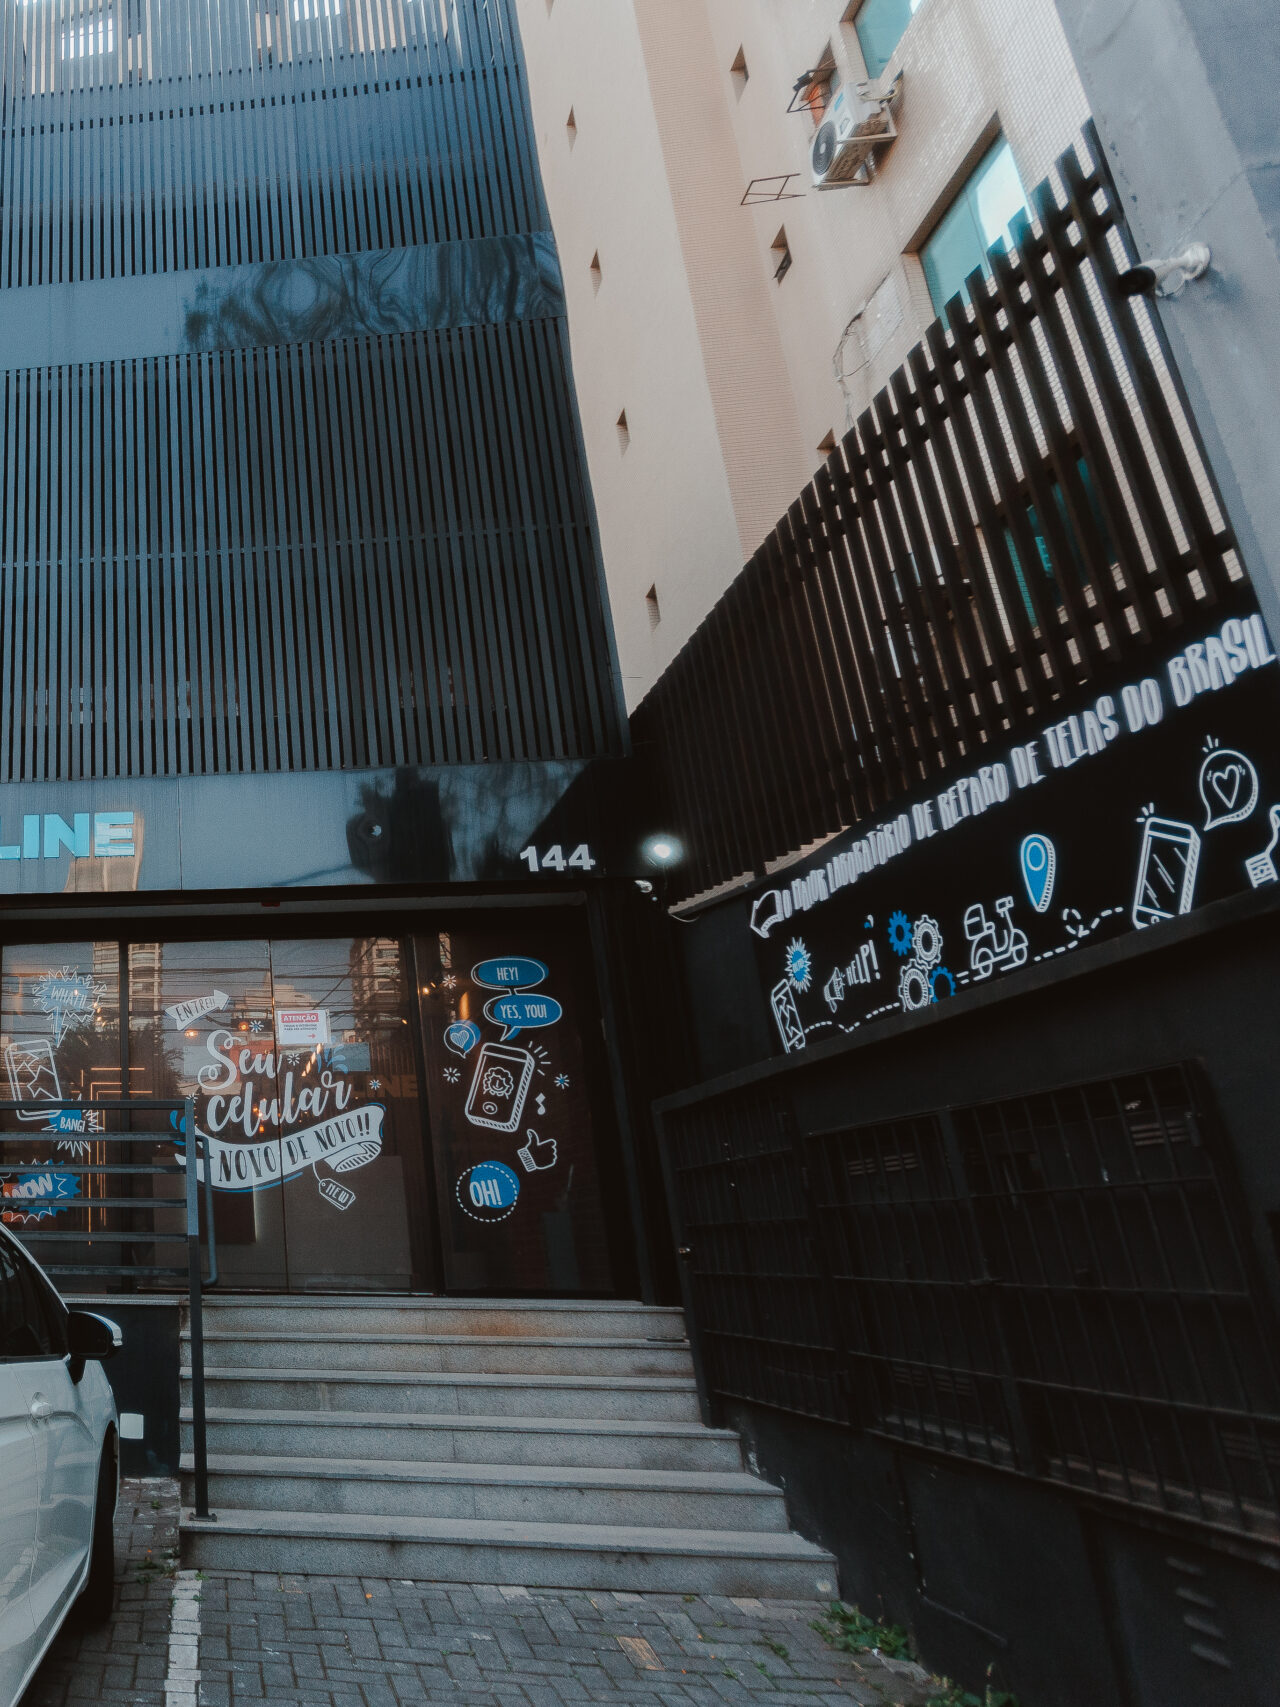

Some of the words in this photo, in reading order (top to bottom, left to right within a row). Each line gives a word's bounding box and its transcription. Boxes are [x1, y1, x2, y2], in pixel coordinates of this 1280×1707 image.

[791, 869, 829, 911] MAIOR
[912, 800, 939, 840] DE
[937, 763, 1010, 831] REPARO
[1010, 741, 1047, 789] DE
[1042, 695, 1120, 768] TELAS
[1121, 678, 1163, 733] DO
[1167, 614, 1277, 707] BRASIL
[520, 844, 596, 872] 144
[496, 967, 519, 981] HEY!
[846, 940, 881, 987] HELP!
[283, 1013, 317, 1023] ATENÇÃO
[500, 1004, 522, 1019] YES,
[525, 1004, 548, 1018] YOU!
[197, 1029, 283, 1090] Seu
[206, 1070, 352, 1137] celular
[218, 1145, 277, 1182] NOVO
[285, 1136, 311, 1165] DE
[314, 1112, 370, 1152] NOVO!!
[325, 1183, 350, 1203] NEW
[469, 1179, 503, 1207] OH!
